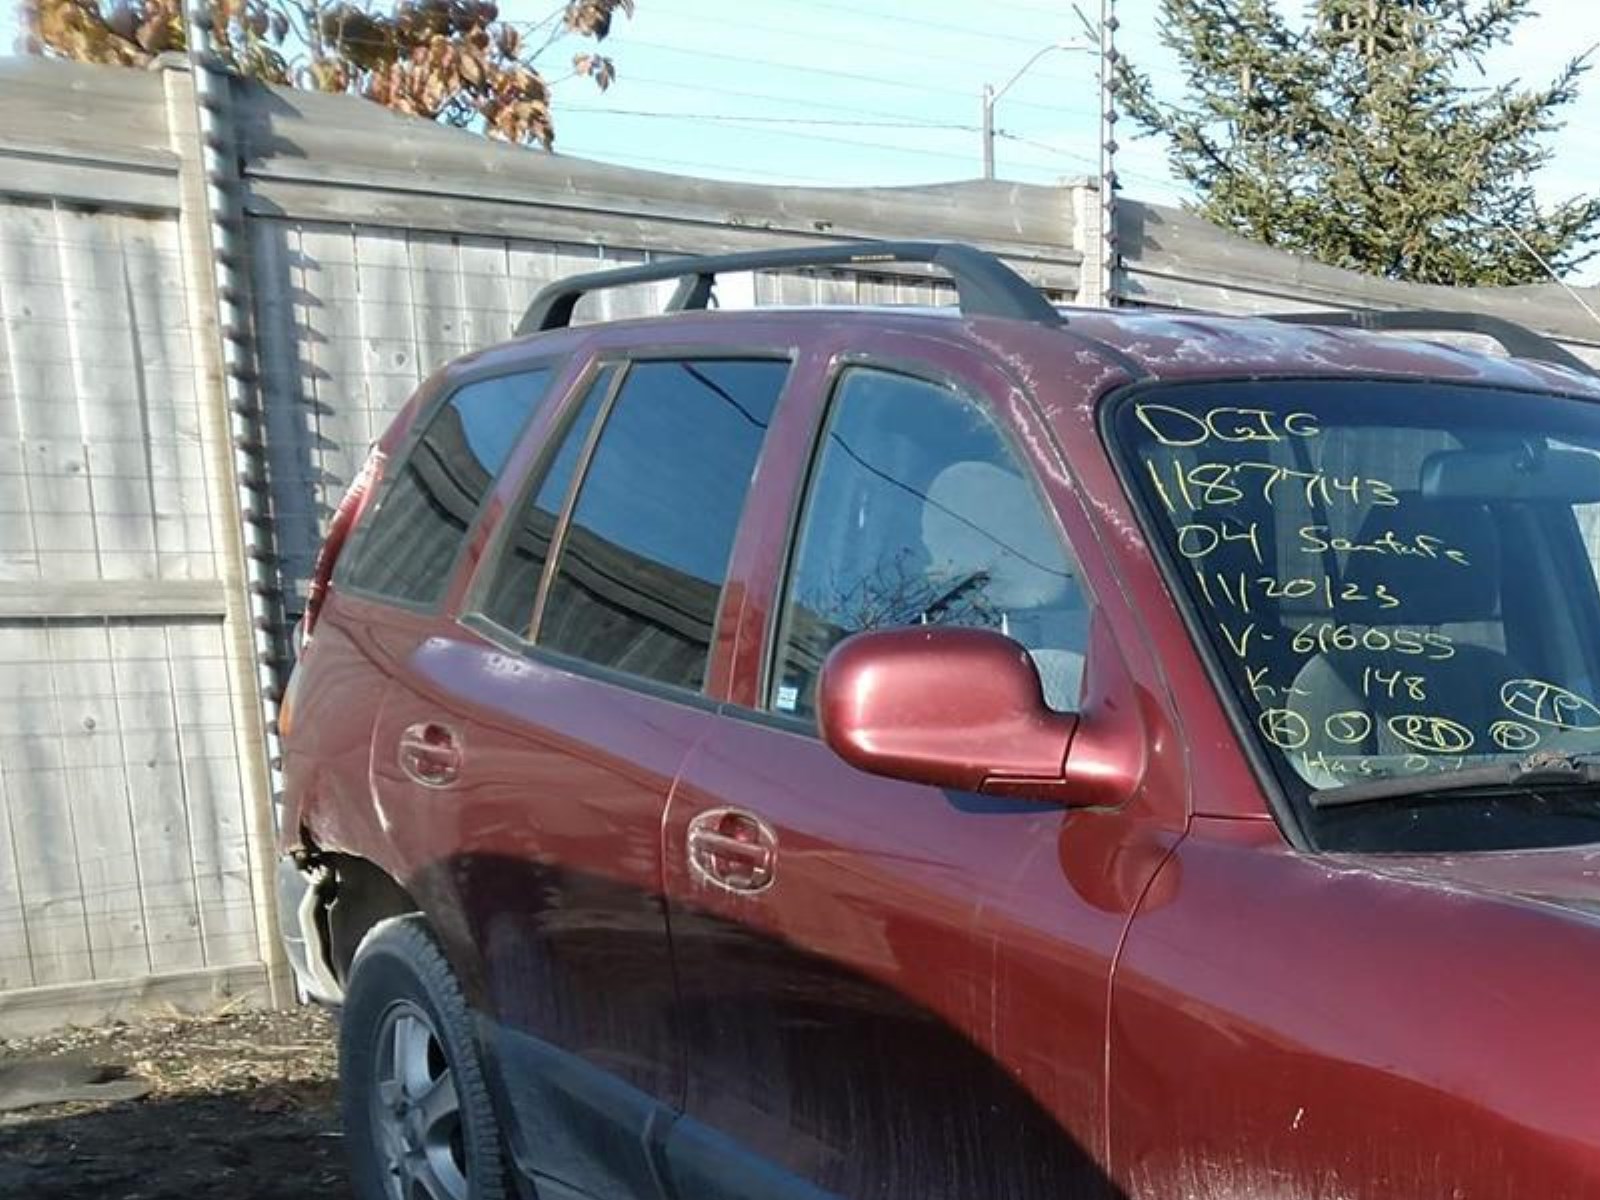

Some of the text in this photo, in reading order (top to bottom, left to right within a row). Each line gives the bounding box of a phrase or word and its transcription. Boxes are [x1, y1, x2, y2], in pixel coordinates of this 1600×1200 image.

[1147, 461, 1399, 512] 11877143
[1179, 522, 1263, 563] 04
[1196, 571, 1400, 614] 11/20/23
[1362, 667, 1426, 700] 148
